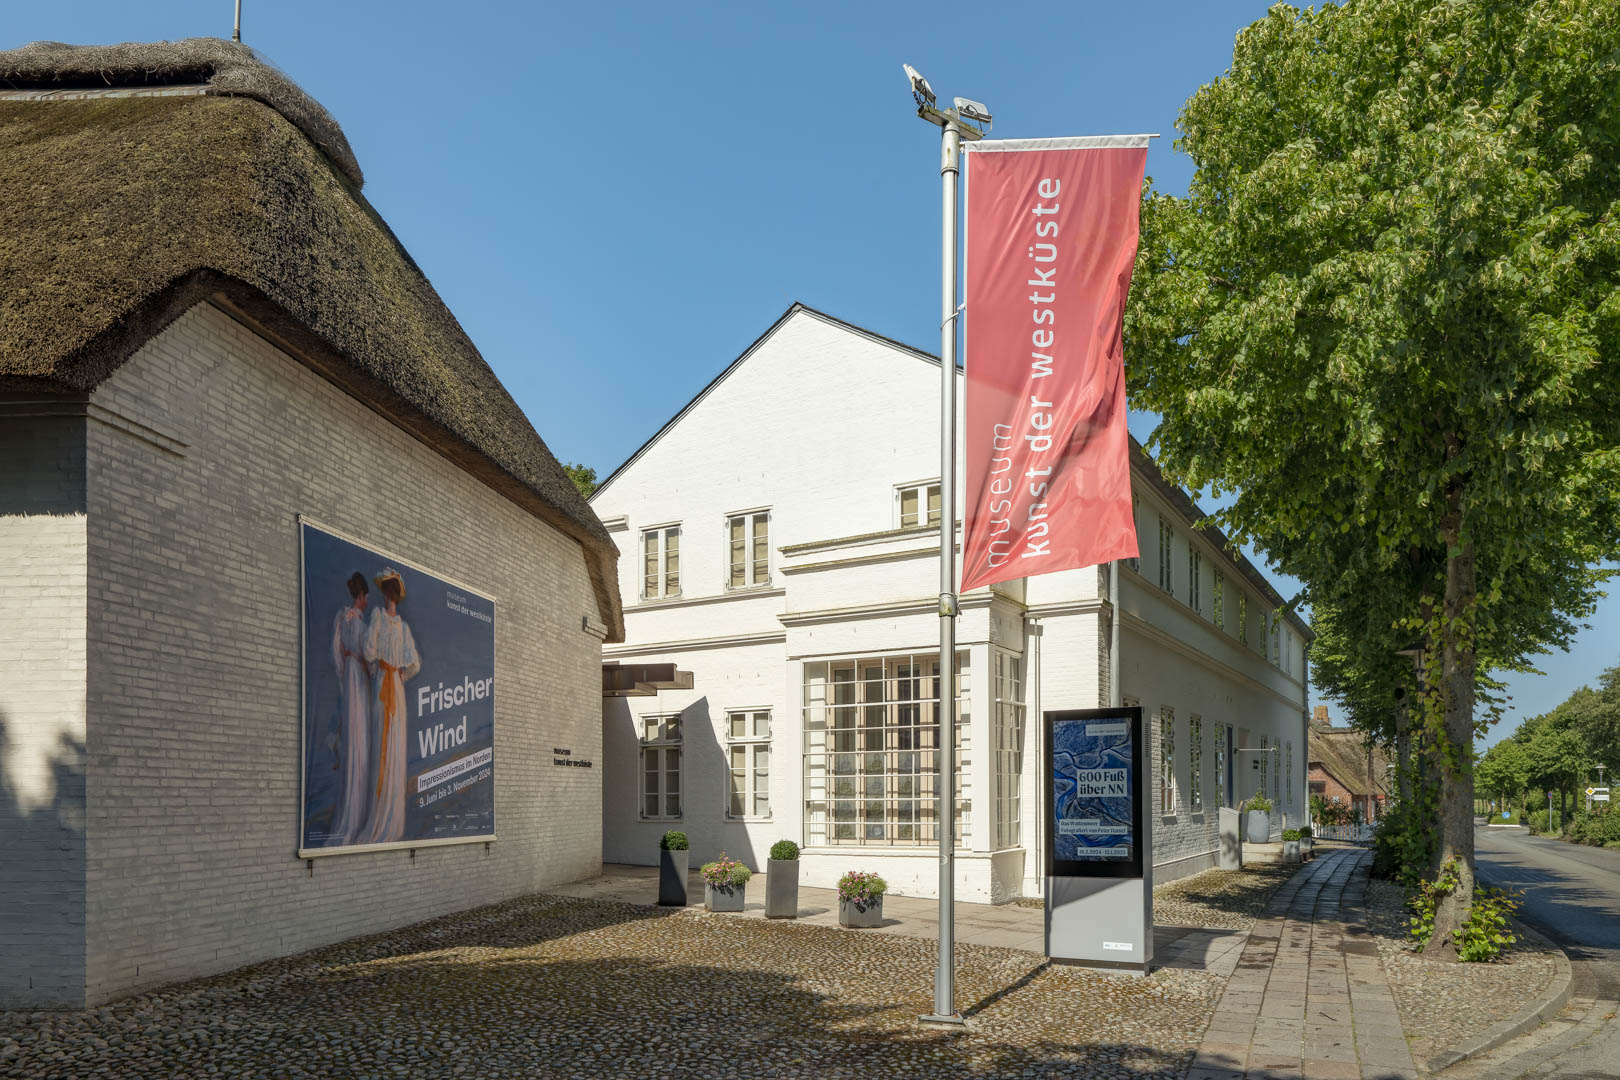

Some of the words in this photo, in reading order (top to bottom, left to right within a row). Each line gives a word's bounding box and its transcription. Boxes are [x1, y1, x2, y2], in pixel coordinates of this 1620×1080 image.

[1028, 178, 1061, 378] westküste
[1025, 396, 1053, 452] der
[987, 423, 1012, 568] museum
[1021, 466, 1053, 559] kunst
[417, 675, 493, 717] Frischer
[418, 715, 467, 759] Wind
[419, 762, 465, 790] Impressionismus
[465, 759, 473, 768] im
[473, 752, 491, 766] Norden
[419, 796, 425, 808] 9.
[426, 790, 438, 806] Juni
[438, 787, 447, 799] bis
[447, 784, 453, 795] 3.
[453, 774, 479, 793] November
[478, 767, 491, 782] 2024
[1079, 771, 1101, 782] 600
[1103, 770, 1125, 782] Fuß
[1080, 784, 1106, 795] über
[1108, 783, 1124, 794] NN
